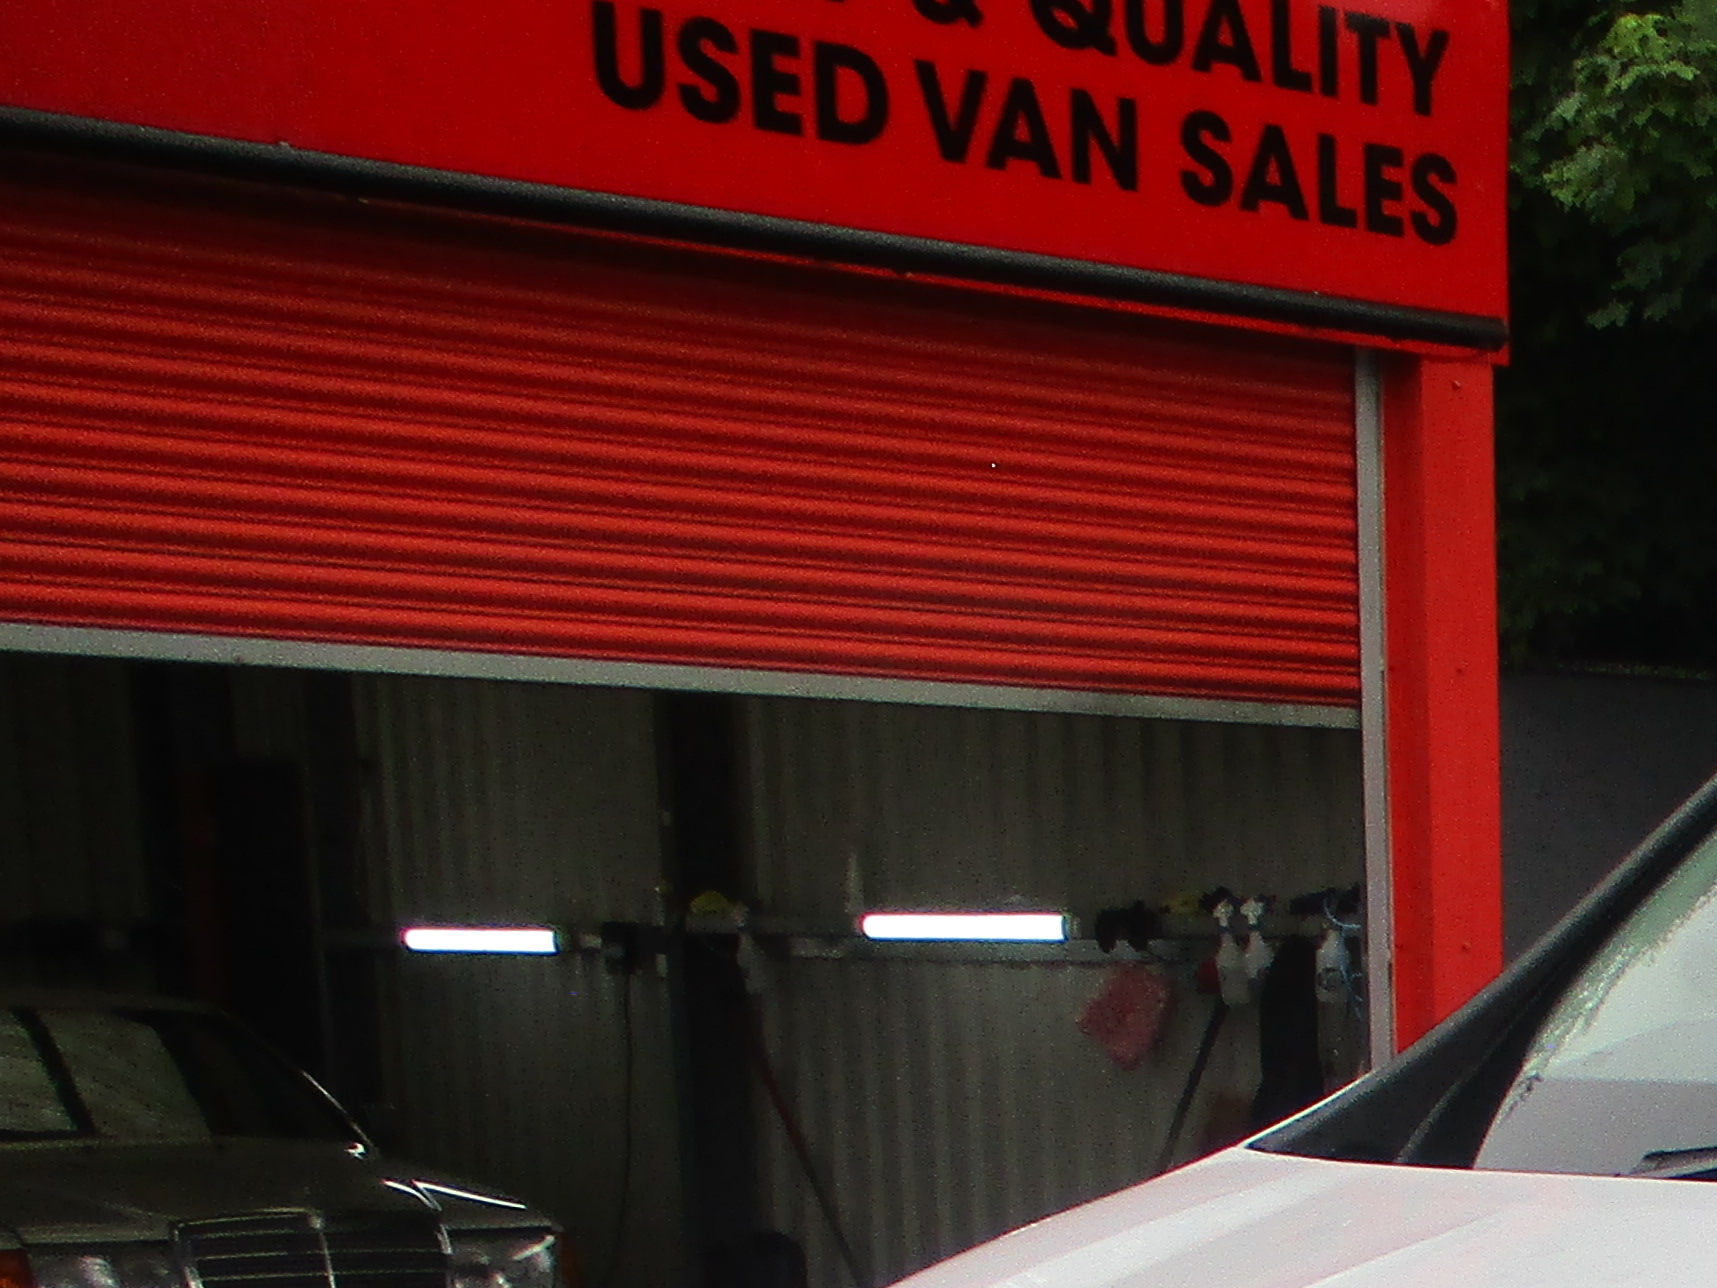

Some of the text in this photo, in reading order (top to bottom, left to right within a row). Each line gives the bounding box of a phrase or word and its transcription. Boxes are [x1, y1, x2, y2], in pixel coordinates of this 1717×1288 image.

[592, 0, 1458, 246] USED VAN SALES
[1030, 0, 1450, 117] QUALITY
